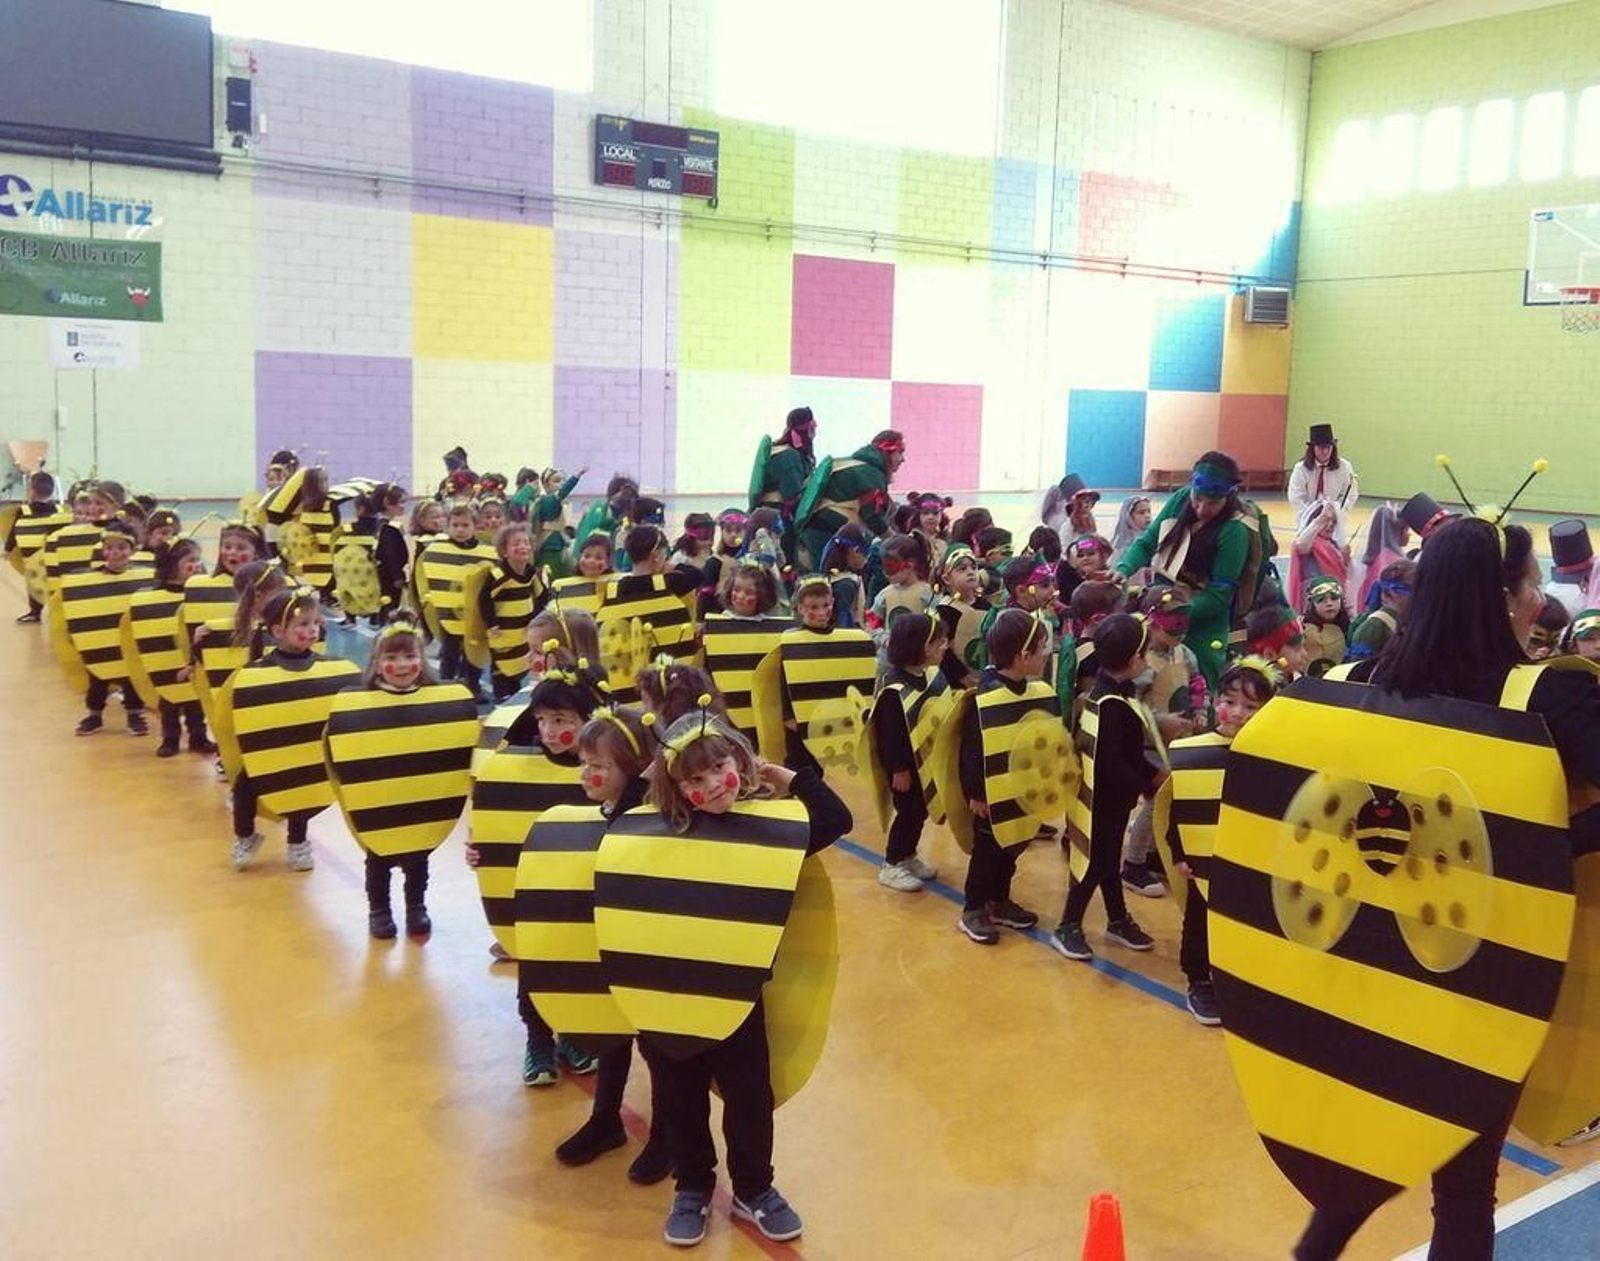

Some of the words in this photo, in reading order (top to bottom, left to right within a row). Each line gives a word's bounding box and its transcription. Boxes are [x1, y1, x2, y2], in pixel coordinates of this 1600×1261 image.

[603, 145, 637, 160] LOCAL
[33, 188, 153, 226] Allariz
[0, 238, 38, 260] CB
[50, 241, 149, 267] Allariz
[59, 292, 107, 307] Allariz
